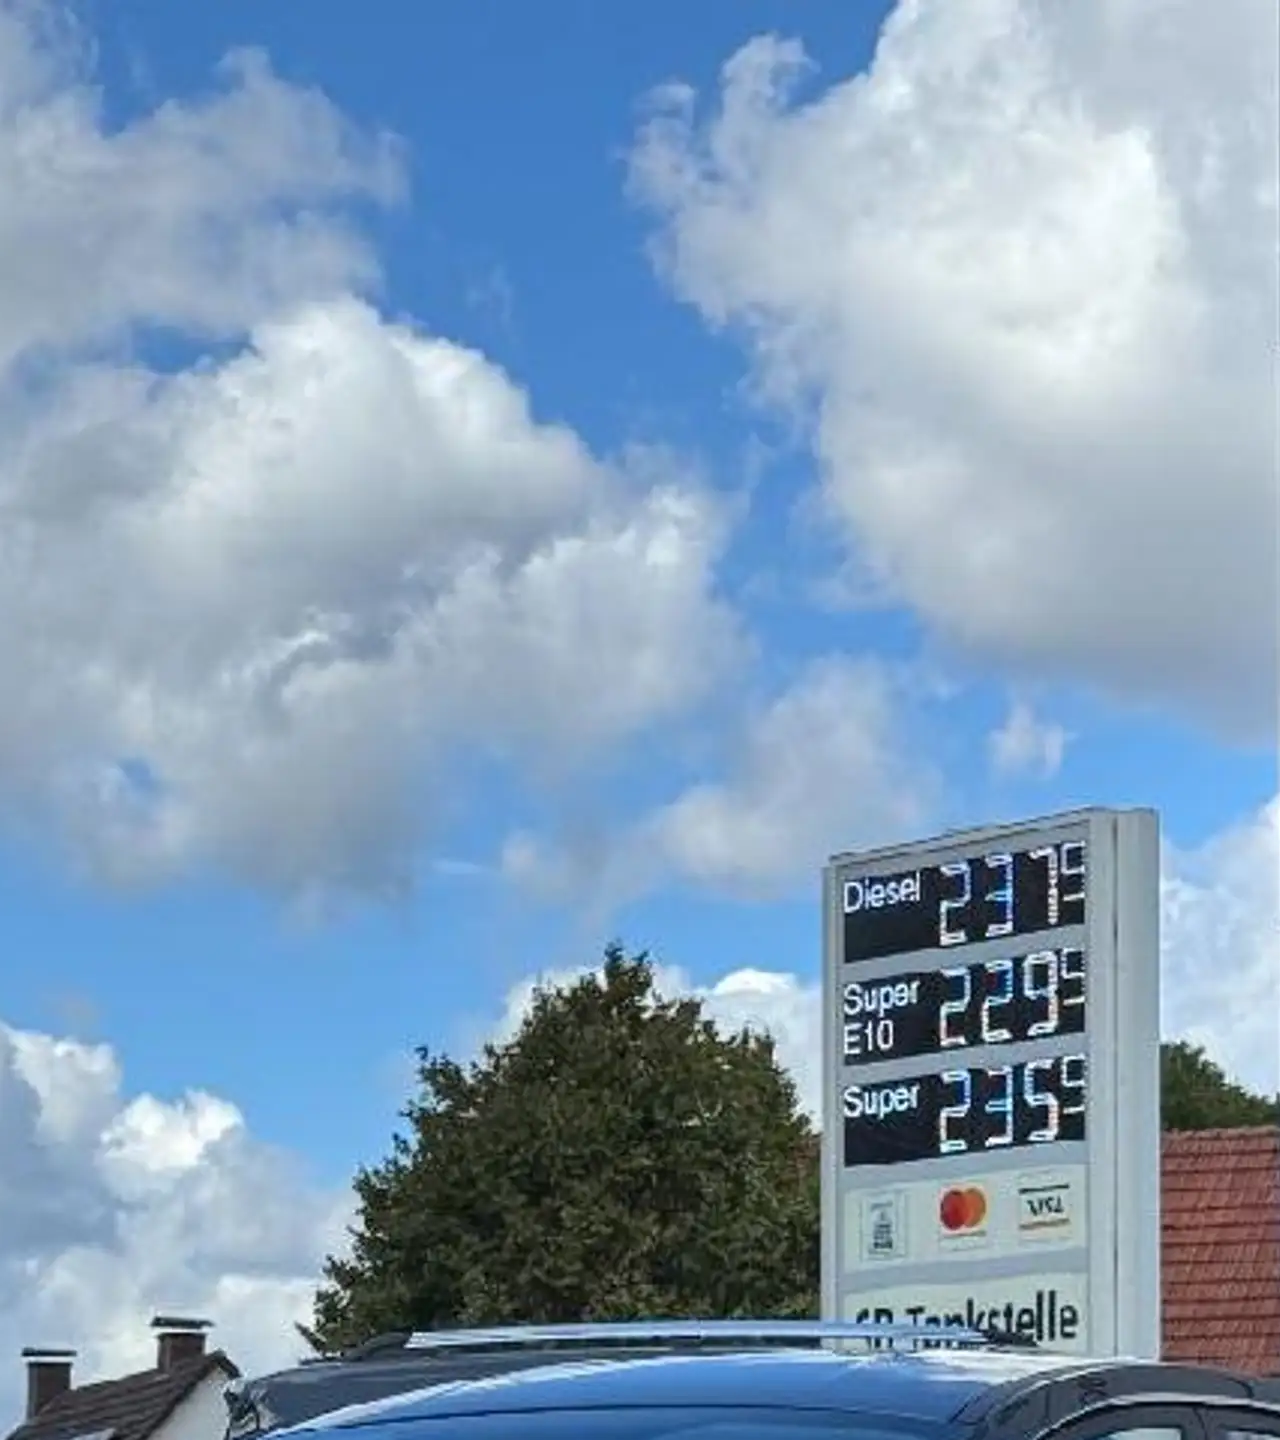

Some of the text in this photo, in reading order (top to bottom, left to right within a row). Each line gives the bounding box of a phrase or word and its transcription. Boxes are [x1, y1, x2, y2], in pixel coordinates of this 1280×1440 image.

[842, 870, 921, 914] Diesel
[842, 980, 921, 1018] Super
[842, 1018, 895, 1055] E10
[842, 1082, 921, 1119] Super
